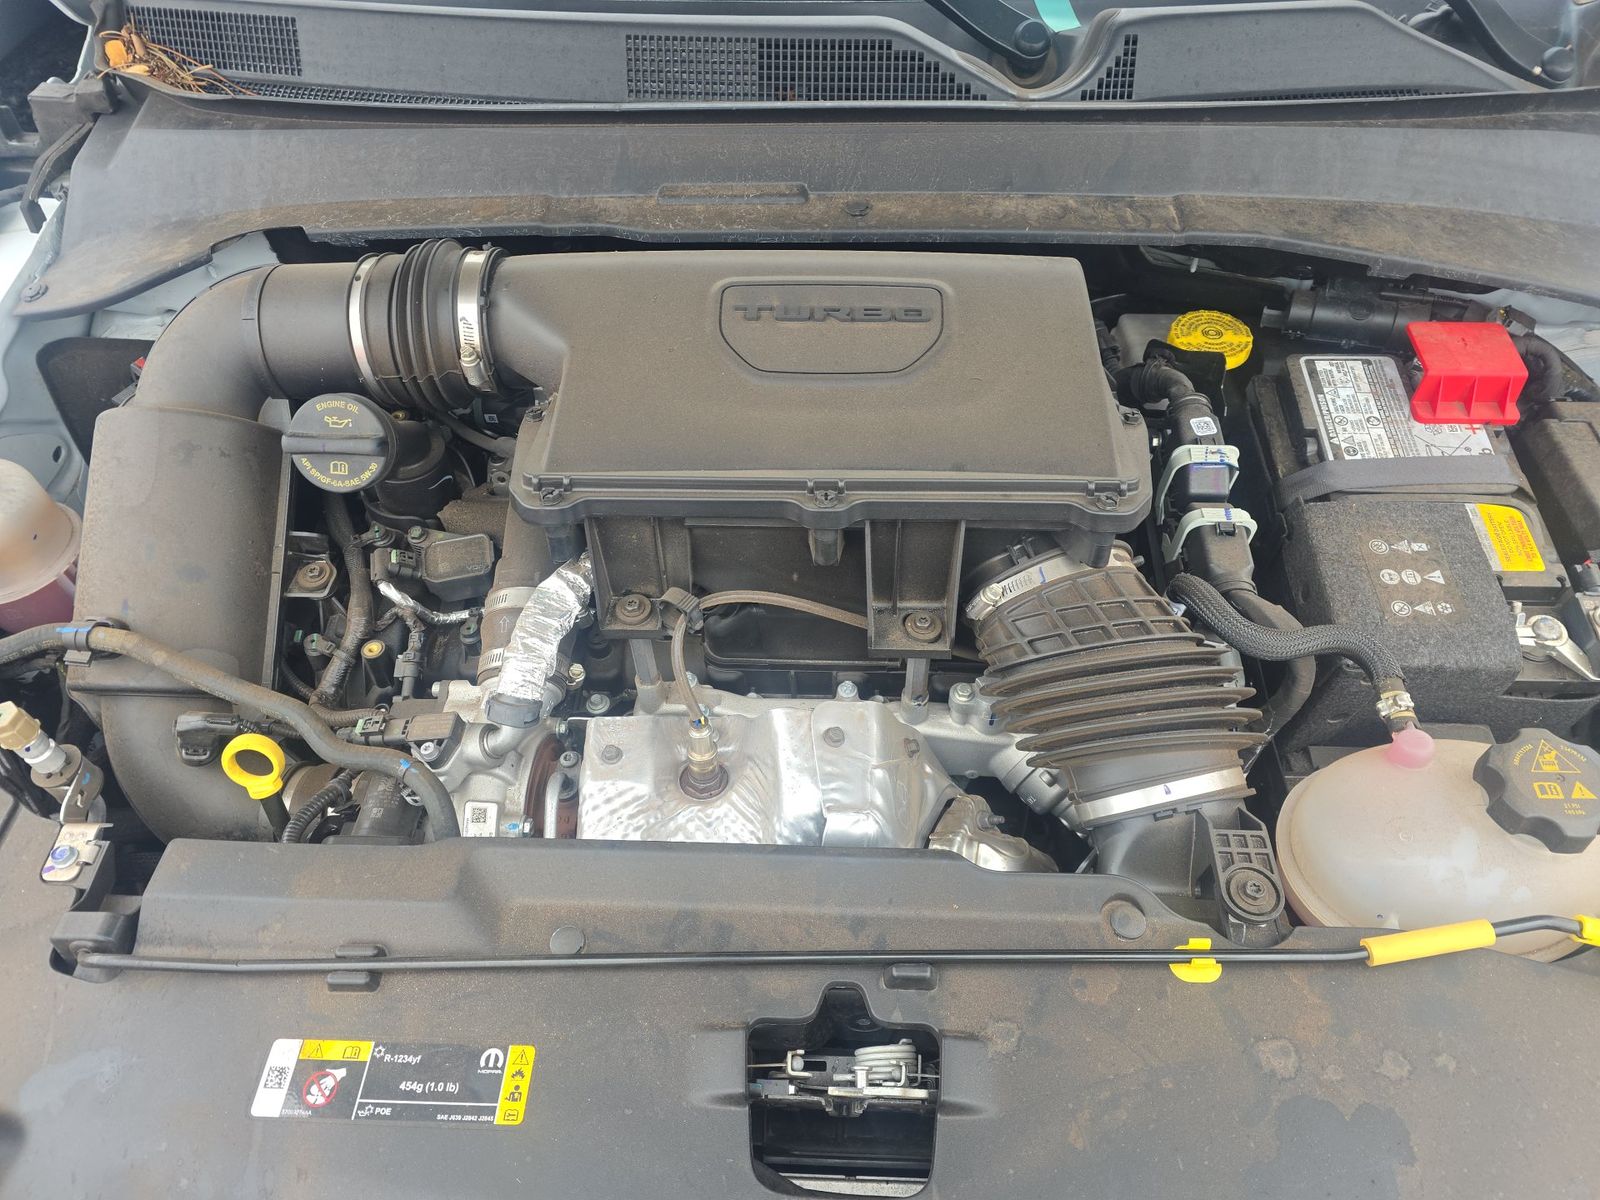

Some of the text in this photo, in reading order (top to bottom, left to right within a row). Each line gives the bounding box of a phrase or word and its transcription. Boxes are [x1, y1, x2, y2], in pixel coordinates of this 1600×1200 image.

[733, 304, 931, 323] TURBO
[315, 400, 360, 414] ENGINE OIL
[383, 1054, 422, 1065] R-1234yf
[399, 1081, 460, 1095] 454g (1.0 lb)
[374, 1107, 392, 1116] POE
